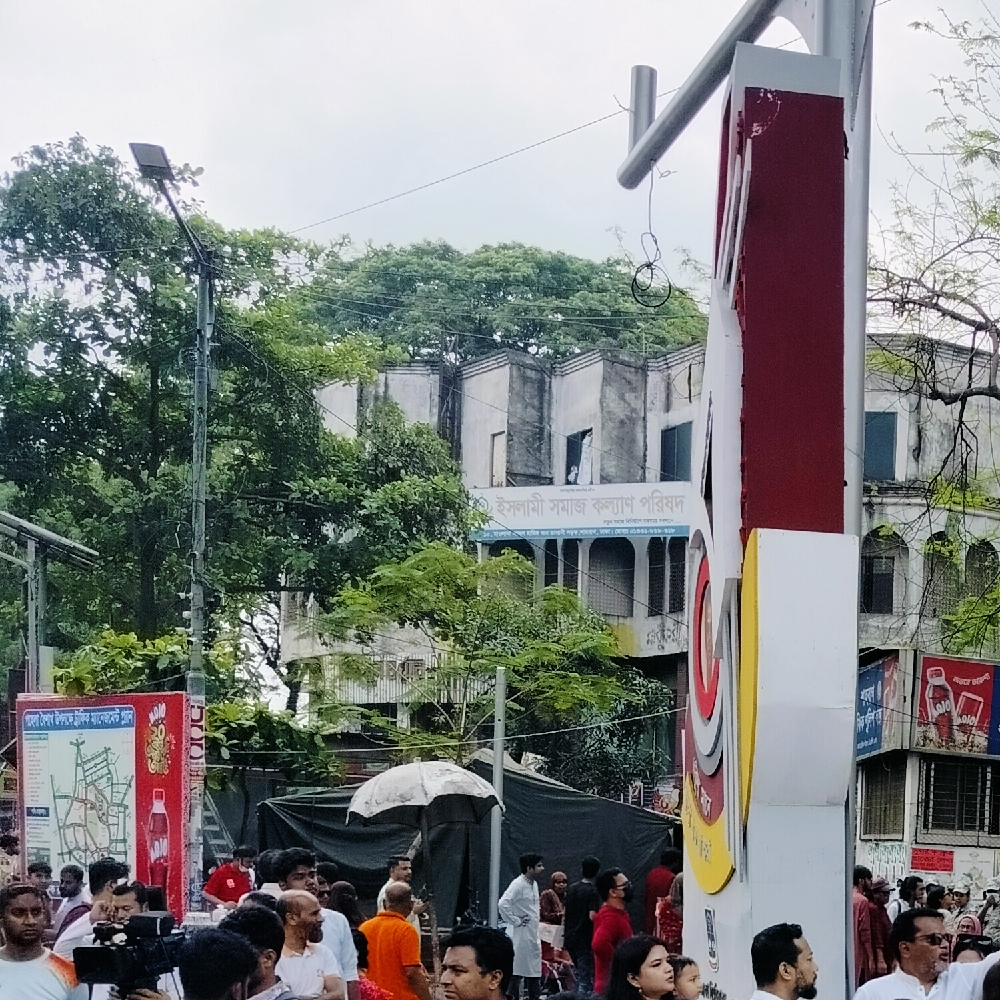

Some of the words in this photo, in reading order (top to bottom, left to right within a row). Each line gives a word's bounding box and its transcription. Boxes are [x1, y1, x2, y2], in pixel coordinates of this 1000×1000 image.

[496, 493, 544, 518] ইসলামী
[550, 498, 589, 517] সমাজ
[592, 495, 635, 516] কল্যাণ
[640, 489, 686, 515] পরিষদ
